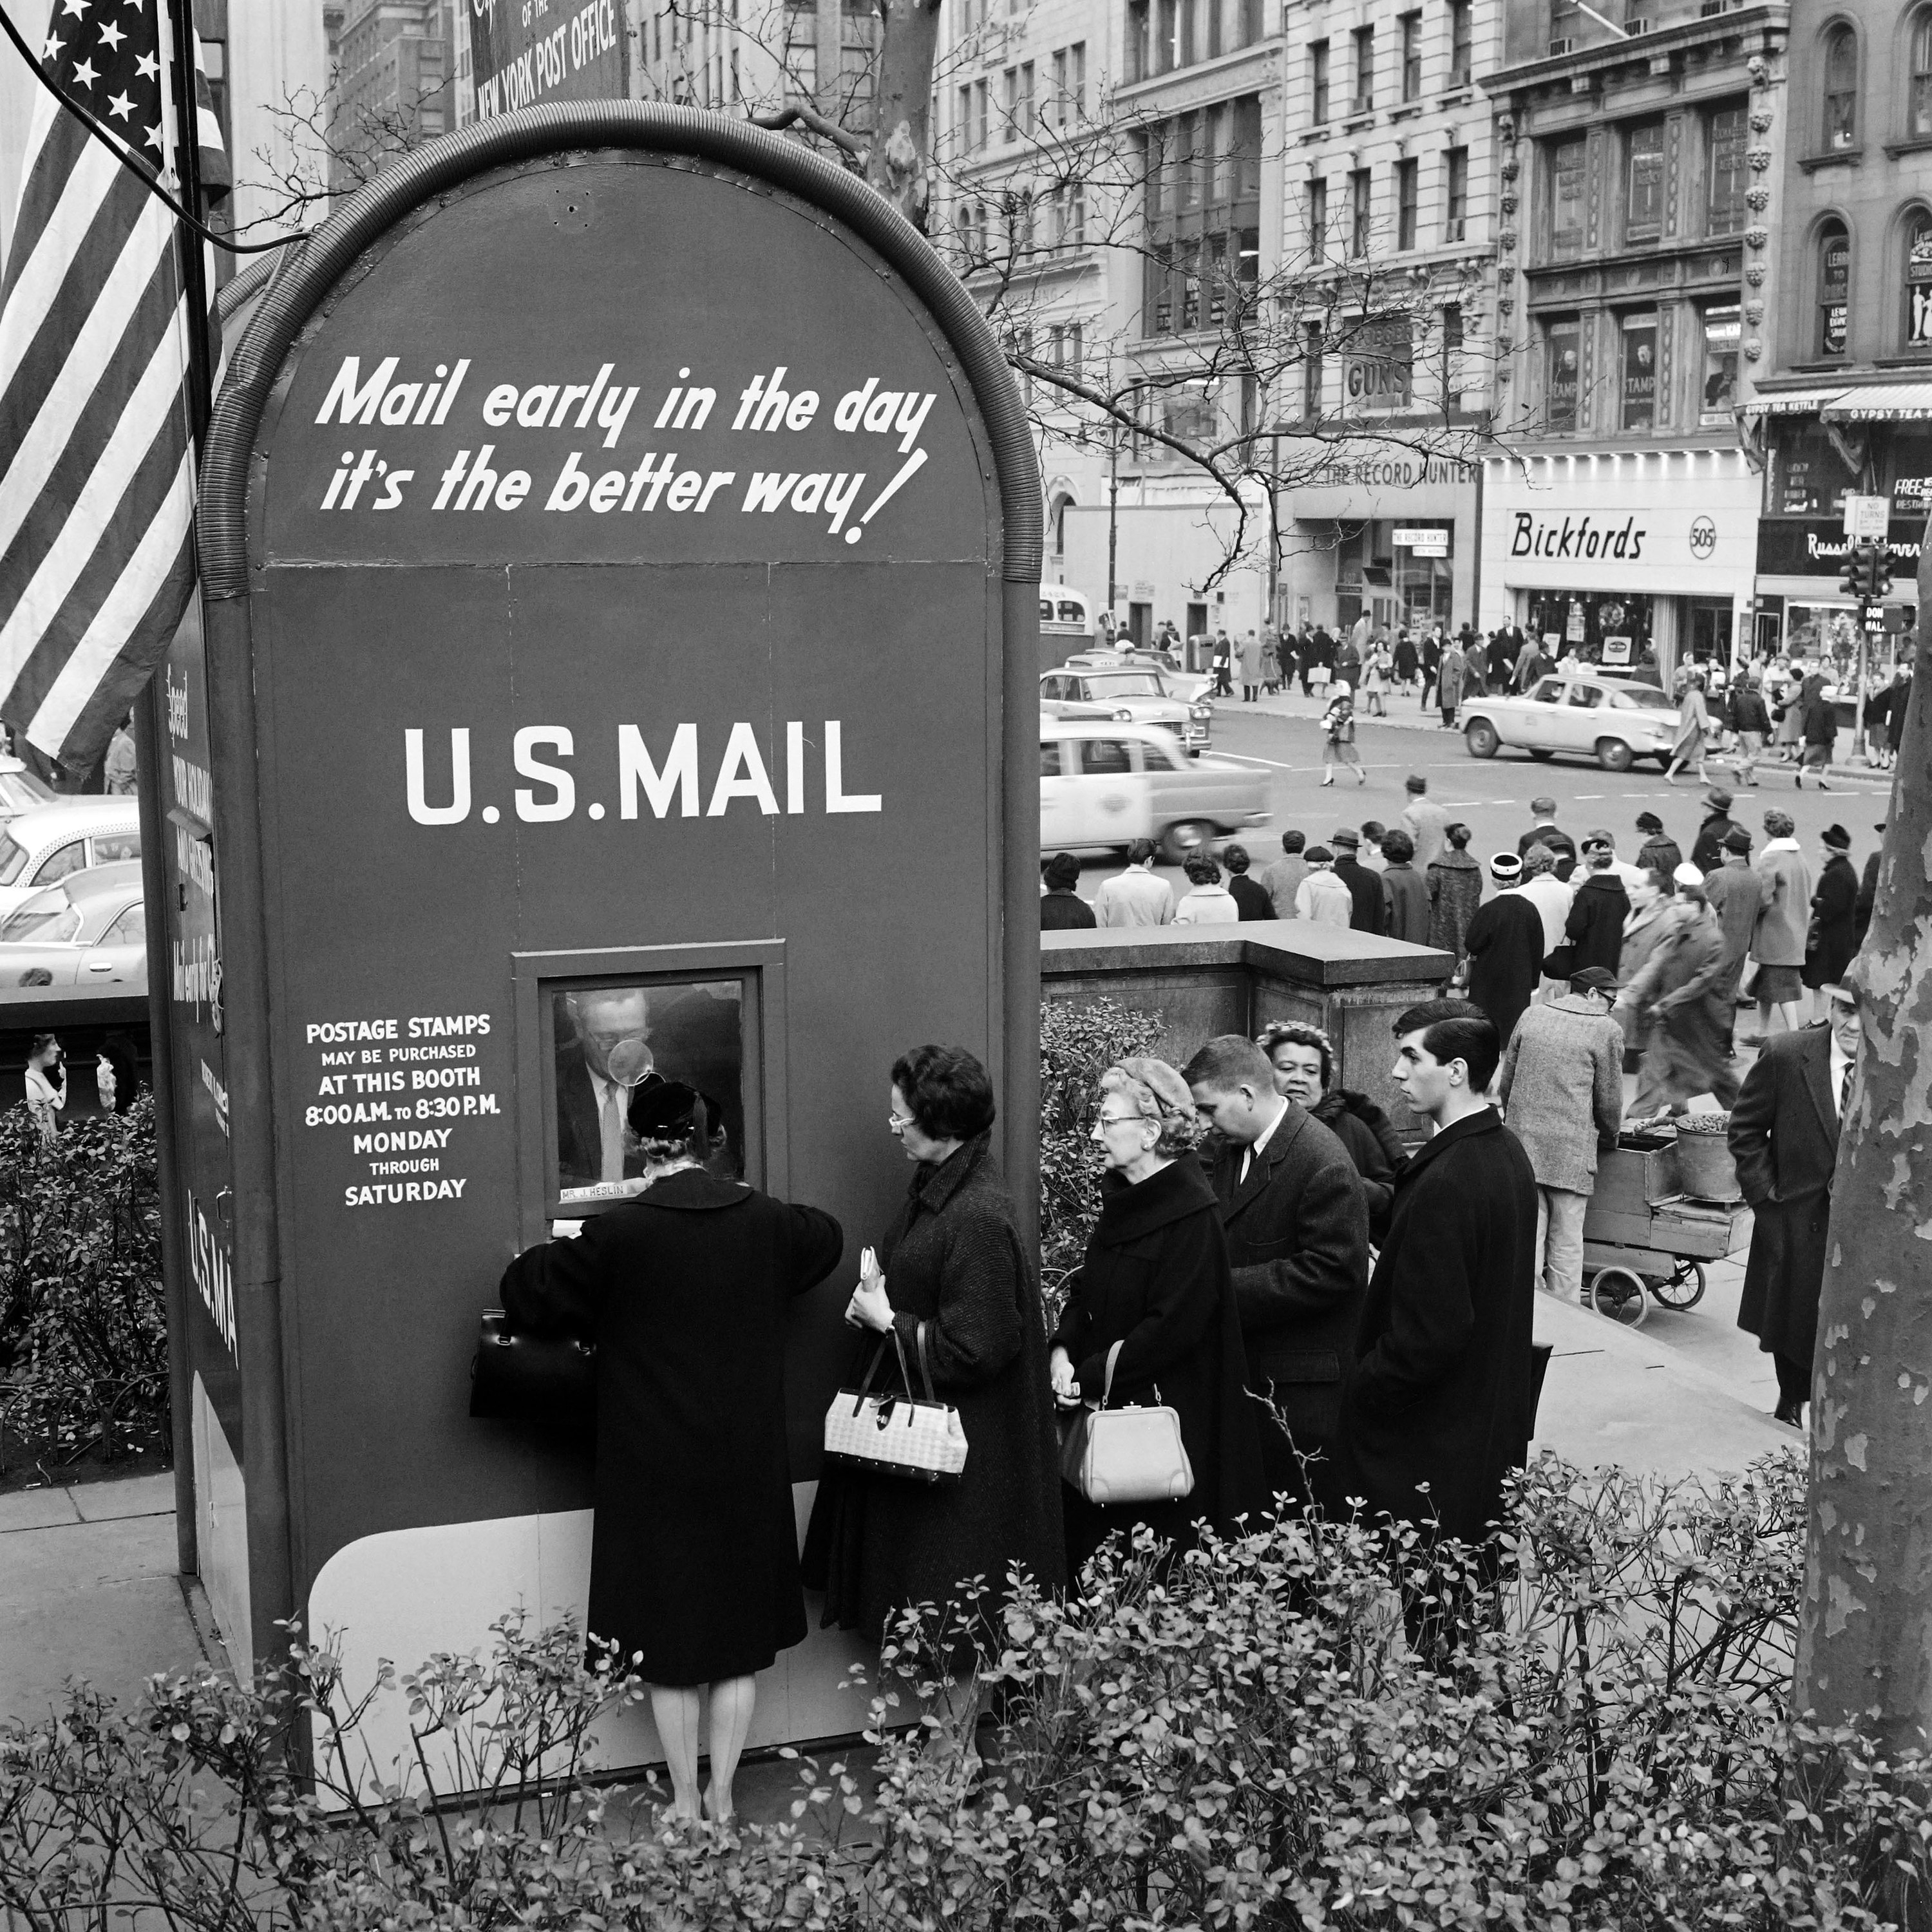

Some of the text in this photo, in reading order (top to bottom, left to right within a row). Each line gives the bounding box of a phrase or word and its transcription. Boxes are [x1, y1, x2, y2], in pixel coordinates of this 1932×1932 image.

[522, 0, 532, 28] OF
[477, 73, 500, 121] NEW
[500, 48, 536, 113] YORK
[535, 23, 567, 96] POST
[571, 0, 617, 71] OFFICE
[1348, 360, 1408, 397] GUNS
[315, 356, 937, 453] Mail early in the day
[1745, 400, 1819, 414] GYPSY TEA KETTLE
[1850, 409, 1895, 420] GYPSY
[1899, 409, 1922, 419] TEA
[320, 449, 416, 511] it's
[431, 444, 532, 511] the
[544, 451, 737, 513] better
[1354, 462, 1413, 484] RECORD
[1418, 460, 1479, 484] HUNTER
[1893, 478, 1924, 495] FREE
[1860, 510, 1885, 518] TURNS
[1404, 533, 1425, 542] RECORD
[1426, 533, 1447, 542] HUNTER
[1511, 512, 1647, 560] Bickfords
[1690, 527, 1716, 548] 505
[165, 663, 189, 748] Speed
[307, 1014, 491, 1044] POSTAGE STAMPS
[321, 1044, 476, 1066] MAY BE PURCHASED
[319, 1066, 480, 1095] AT THIS BOOTH
[394, 1106, 412, 1121] TO
[415, 1096, 460, 1119] 8:30
[463, 1094, 501, 1115] P.M.
[354, 1128, 453, 1155] MONDAY
[369, 1157, 440, 1176] THROUGH
[345, 1179, 467, 1206] SATURDAY
[562, 1186, 624, 1199] MR. J. HESLIN
